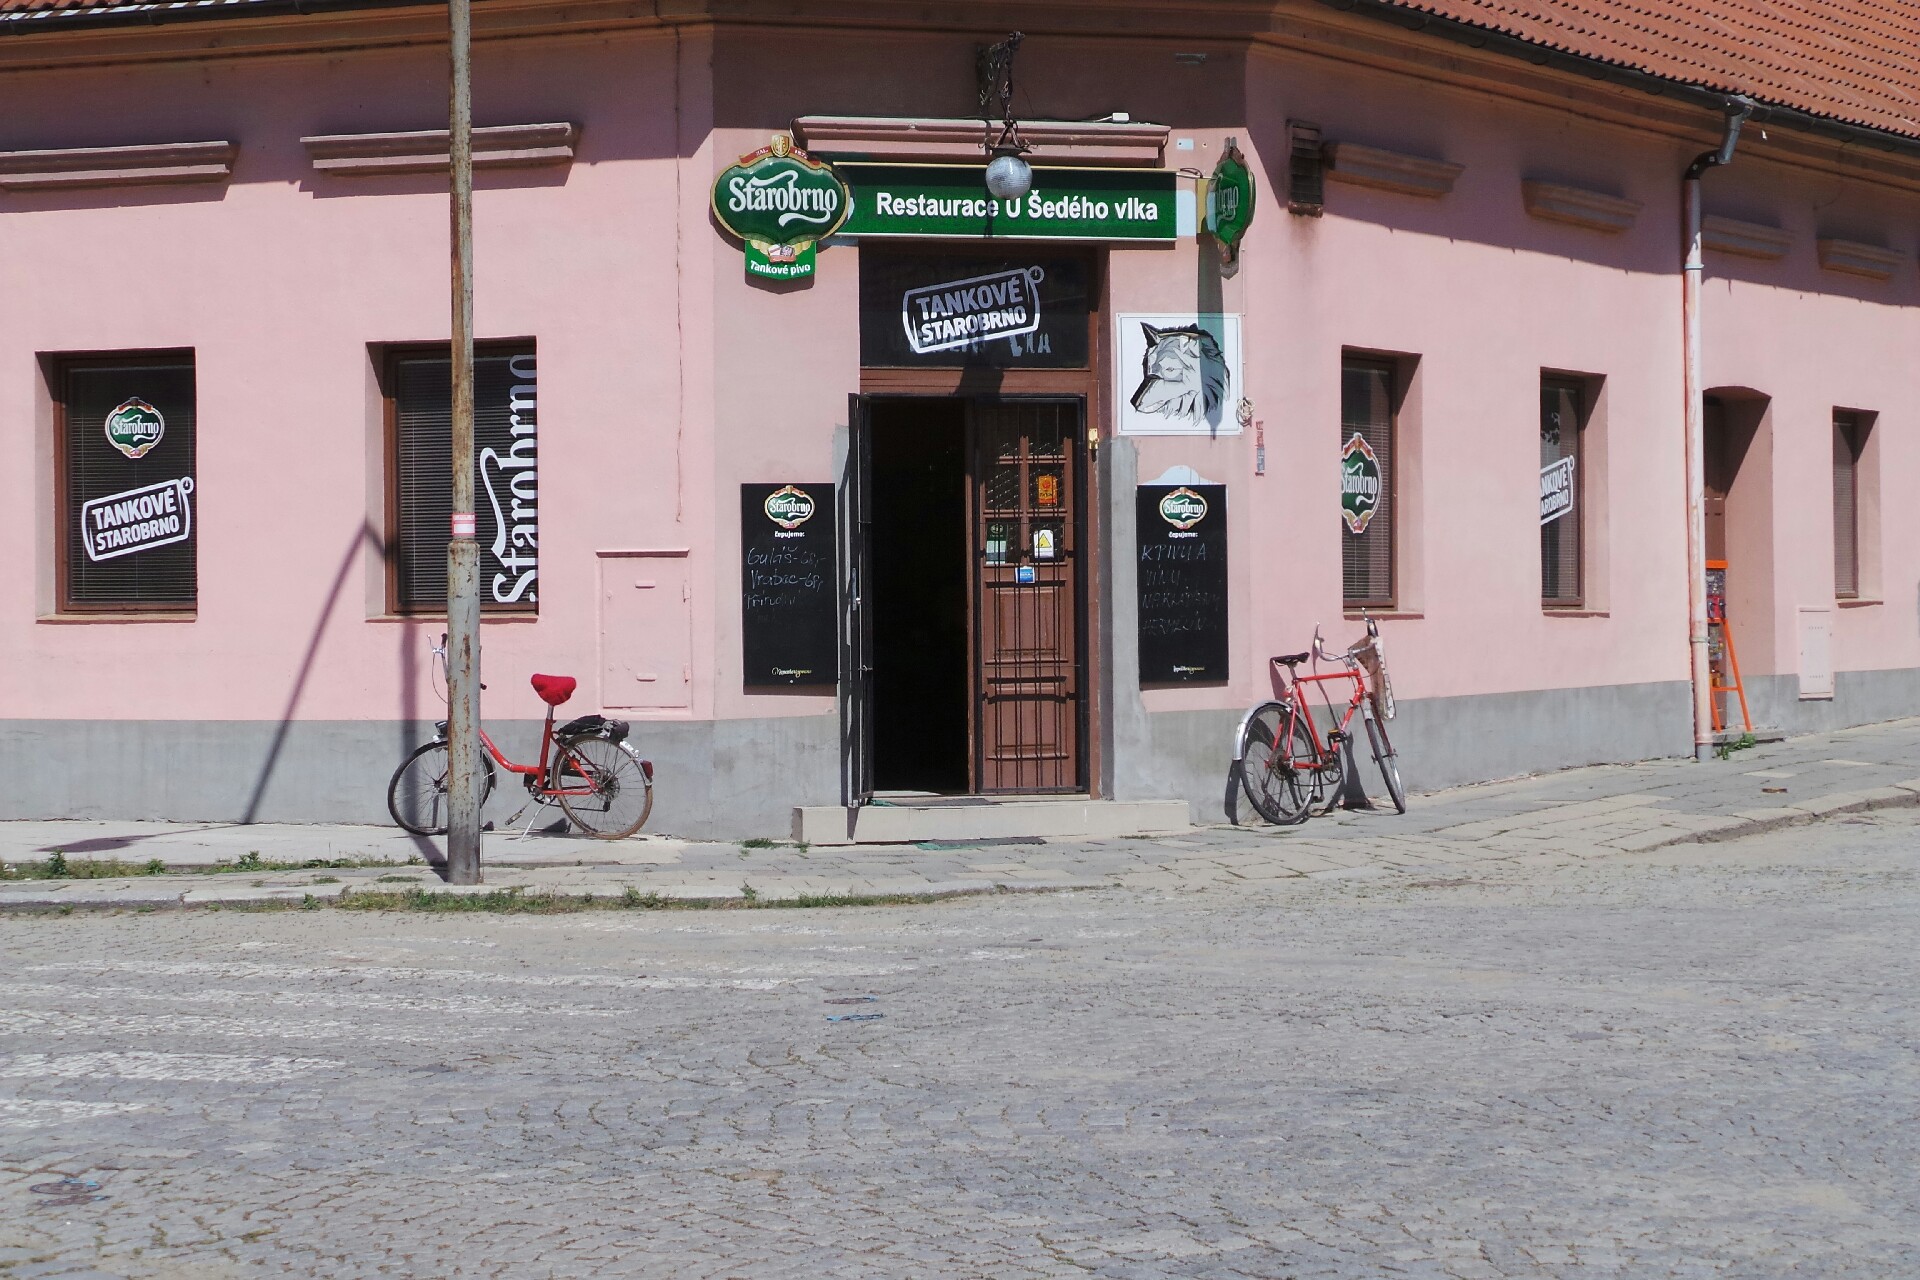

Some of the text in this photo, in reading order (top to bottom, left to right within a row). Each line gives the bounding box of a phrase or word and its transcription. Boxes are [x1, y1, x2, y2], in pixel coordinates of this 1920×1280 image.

[728, 169, 838, 228] Starobrno
[876, 190, 1158, 220] Restaurace U Šedého vlka
[750, 260, 811, 276] Tankové pivo
[915, 276, 1024, 321] TANKOVÉ
[921, 305, 1027, 343] STAROBRNO
[112, 414, 160, 442] Starobrno
[479, 354, 538, 603] Starobrno
[92, 487, 177, 530] TANKOVÉ
[769, 497, 811, 519] Starobrno
[1164, 498, 1204, 519] Starobrno
[95, 515, 180, 551] STAROBRNO
